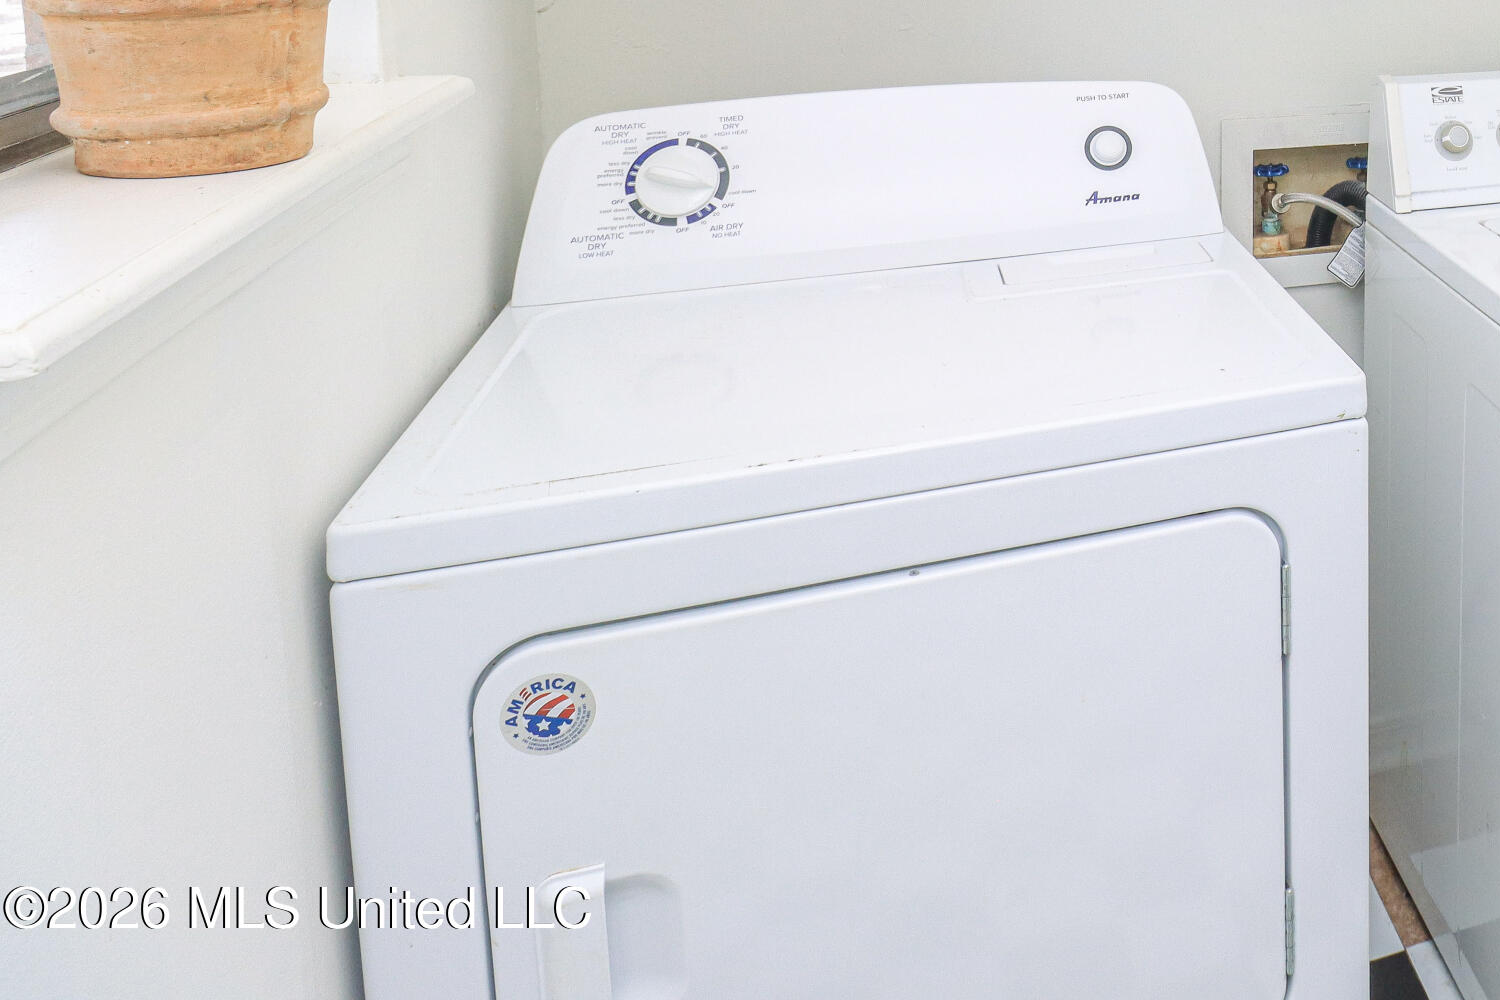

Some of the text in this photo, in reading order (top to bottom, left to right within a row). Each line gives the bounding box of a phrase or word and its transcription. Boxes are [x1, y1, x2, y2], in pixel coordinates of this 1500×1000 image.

[1108, 92, 1130, 100] START
[719, 115, 744, 123] TIMED
[594, 122, 647, 132] AUTOMATIC
[611, 131, 630, 139] DRY
[1085, 190, 1140, 206] Amana
[710, 222, 744, 232] AIR DRY
[570, 232, 625, 244] AUTOMATIC
[587, 242, 607, 250] DRY
[578, 251, 595, 259] LOW
[505, 677, 577, 727] AMERICA
